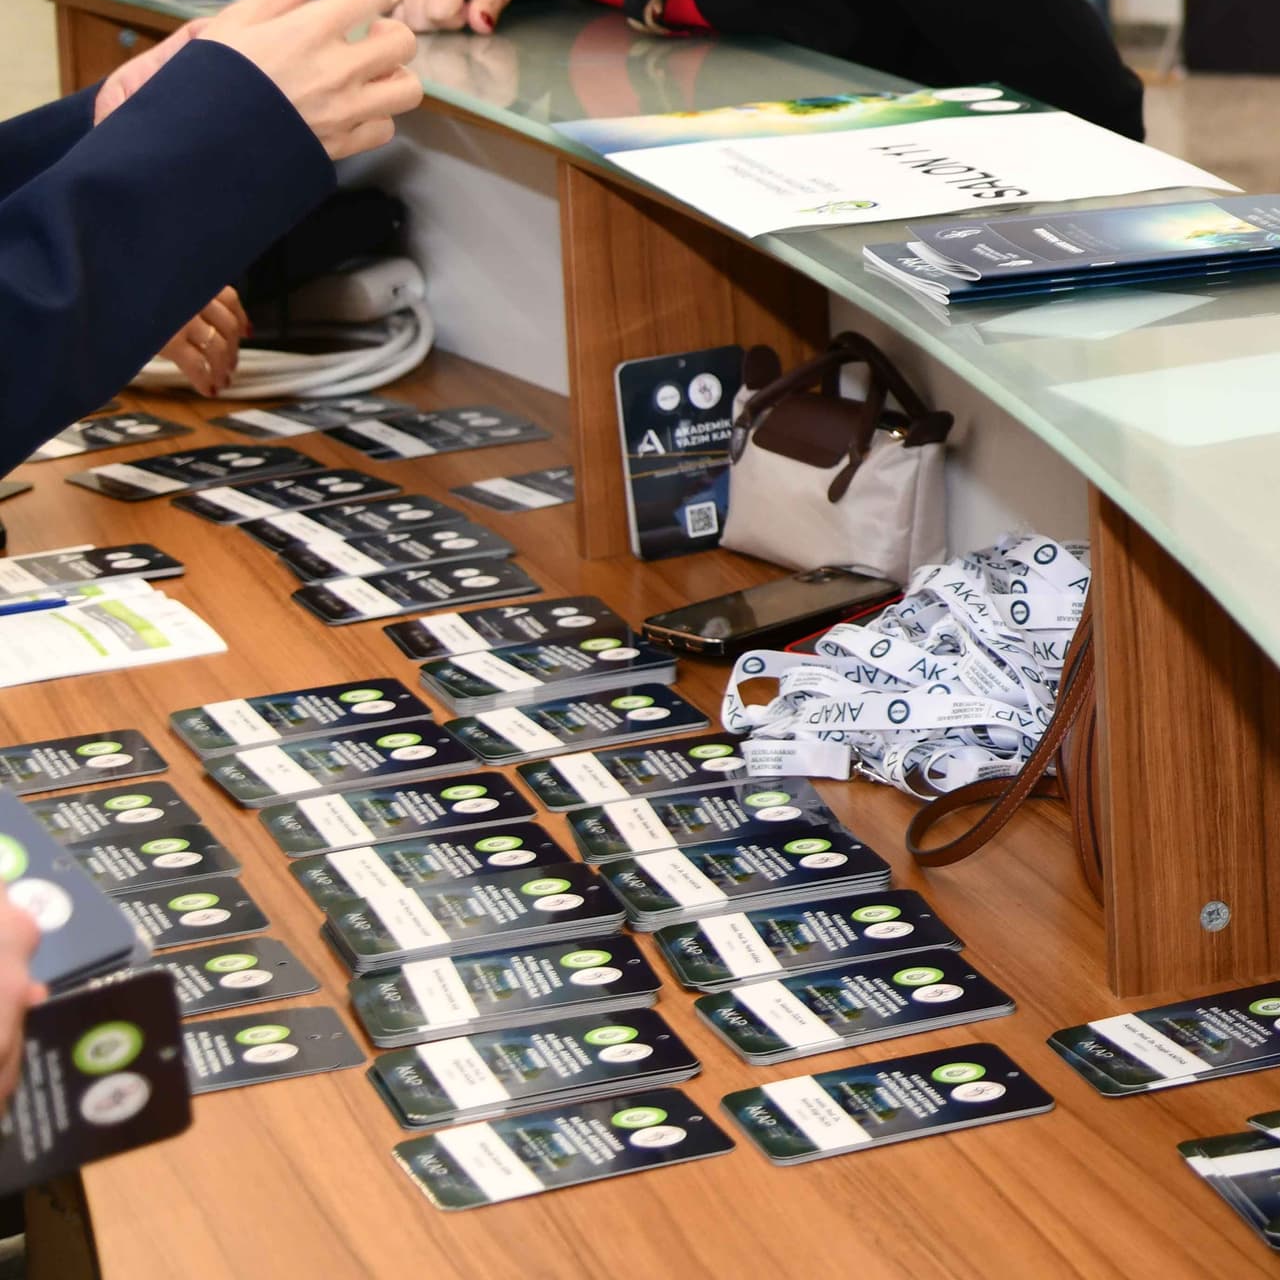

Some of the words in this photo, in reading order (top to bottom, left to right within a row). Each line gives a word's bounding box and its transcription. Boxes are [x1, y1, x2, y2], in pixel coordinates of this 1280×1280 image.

[898, 155, 1030, 200] SALON
[675, 418, 732, 438] AKADEMİK
[676, 433, 710, 449] YAZIM
[808, 701, 865, 725] AKAP
[1080, 1039, 1115, 1059] AKAP
